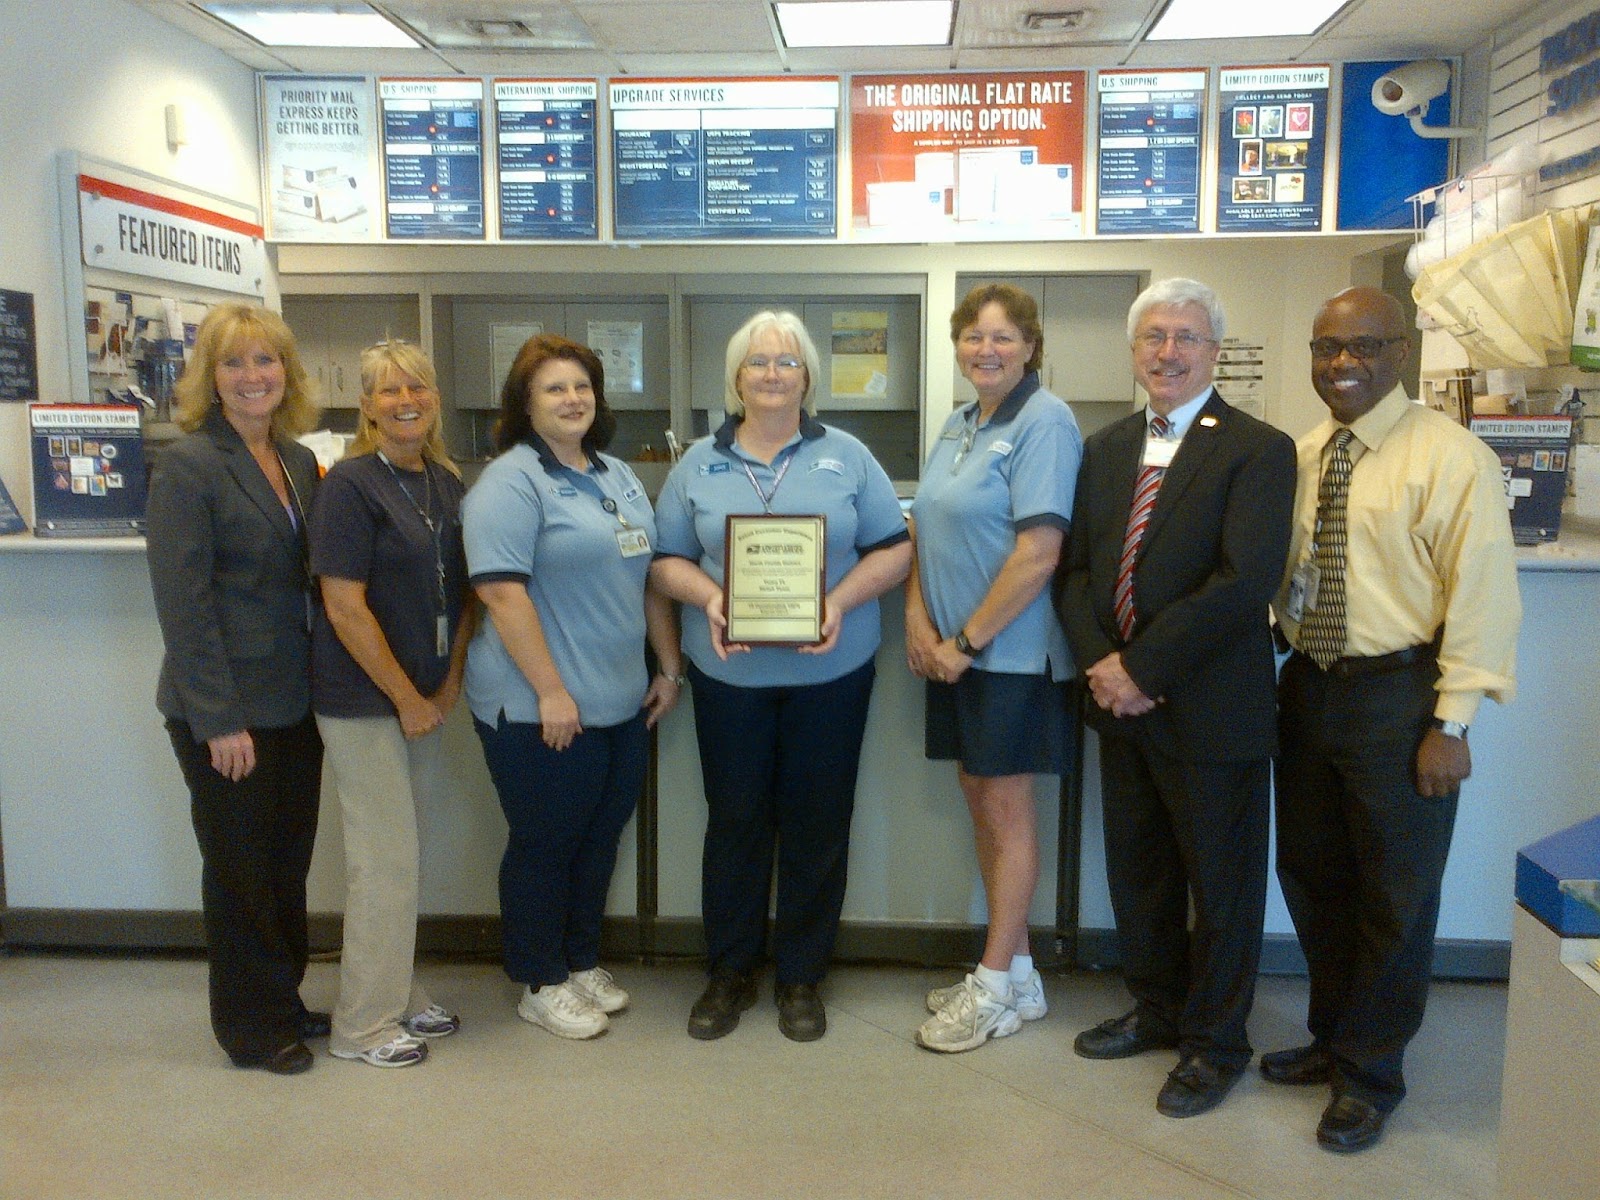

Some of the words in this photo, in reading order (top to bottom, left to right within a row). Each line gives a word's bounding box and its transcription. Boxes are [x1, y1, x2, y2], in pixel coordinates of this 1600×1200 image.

[1120, 77, 1158, 86] SHIPPING
[1225, 75, 1257, 85] LIMITED
[1260, 74, 1290, 84] EDITION
[1293, 73, 1325, 83] STAMPS
[401, 84, 437, 95] SHIPPING
[498, 86, 554, 95] INTERNATIONAL
[558, 86, 593, 95] SHIPPING
[613, 89, 664, 103] UPGRADE
[669, 89, 724, 102] SERVICES
[864, 84, 897, 107] THE
[901, 83, 981, 106] ORIGINAL
[986, 82, 1026, 104] FLAT
[1031, 81, 1073, 104] RATE
[281, 90, 328, 104] PRIORITY
[330, 90, 354, 104] MAIL
[279, 106, 324, 119] EXPRESS
[326, 106, 358, 119] KEEPS
[892, 110, 973, 132] SHIPPING
[979, 108, 1046, 131] OPTION.
[276, 121, 320, 135] GETTING
[322, 121, 363, 135] BETTER.
[118, 213, 198, 265] FEATURED
[202, 235, 242, 276] ITEMS
[34, 414, 68, 423] LIMITED
[70, 414, 102, 424] EDITION
[104, 414, 137, 424] STAMPS
[1472, 424, 1502, 433] LIMITED
[1505, 424, 1535, 433] EDITION
[1537, 424, 1569, 433] STAMPS
